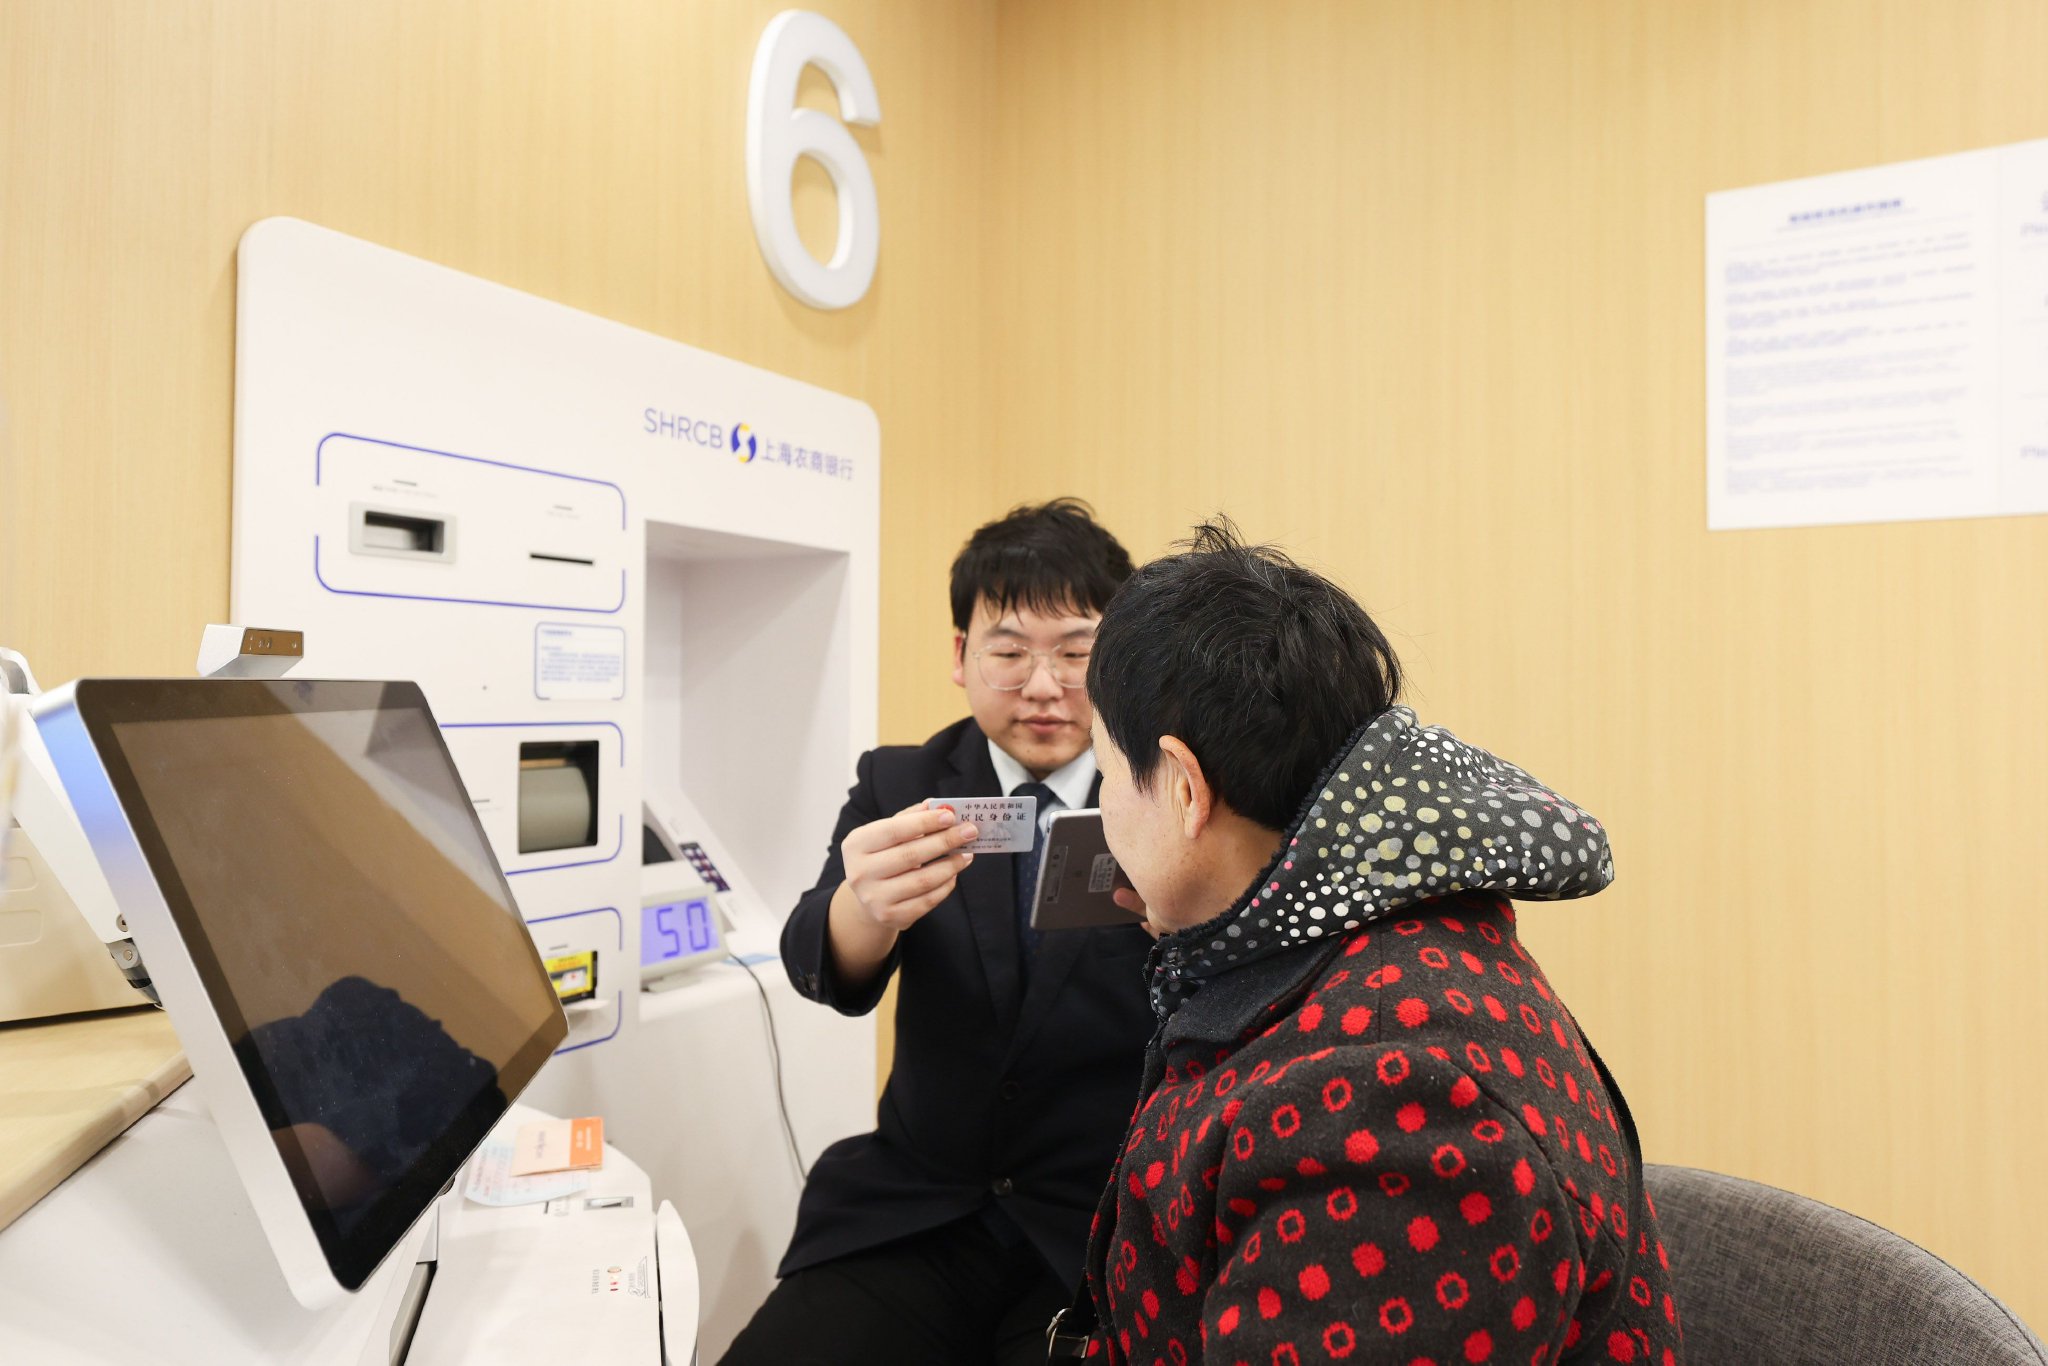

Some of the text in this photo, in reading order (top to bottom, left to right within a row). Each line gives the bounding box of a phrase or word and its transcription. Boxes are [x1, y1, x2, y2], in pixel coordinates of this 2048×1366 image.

[746, 8, 881, 311] 6
[644, 407, 723, 450] SHRCB
[761, 438, 854, 481] 上海农商银行
[961, 812, 1027, 822] 居民身份证
[965, 802, 1023, 810] 中华人民共和国
[656, 902, 710, 958] 50
